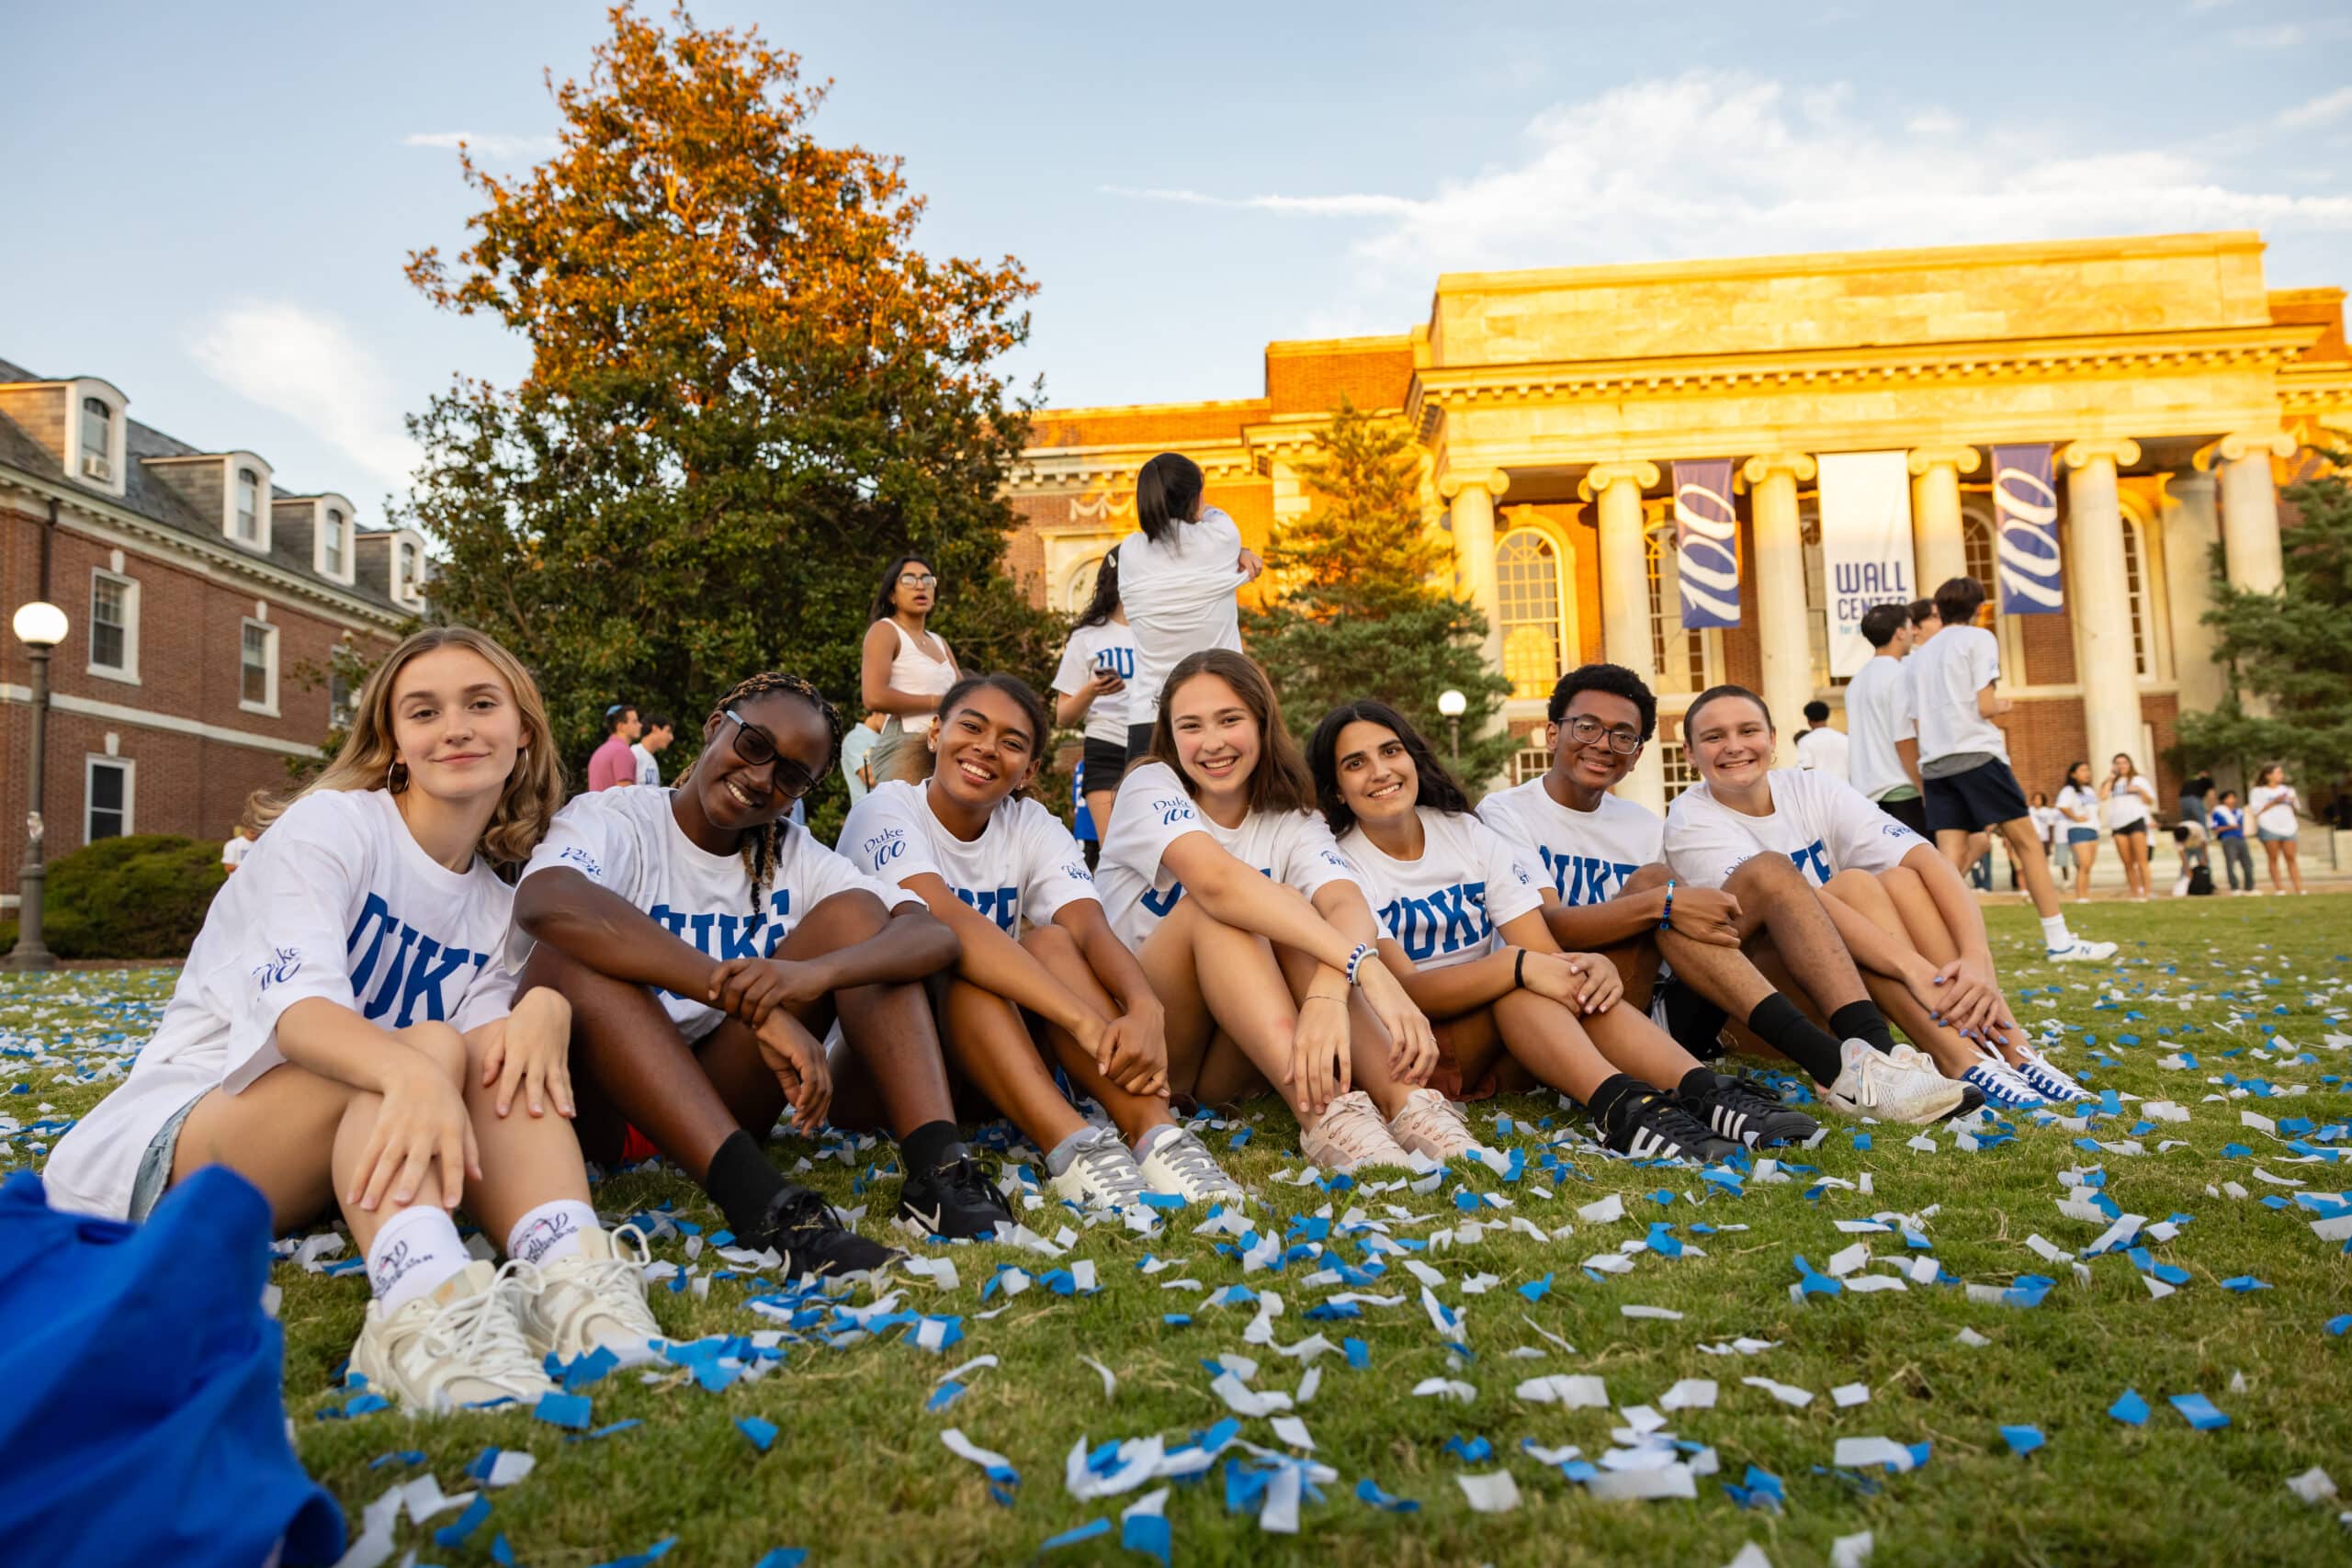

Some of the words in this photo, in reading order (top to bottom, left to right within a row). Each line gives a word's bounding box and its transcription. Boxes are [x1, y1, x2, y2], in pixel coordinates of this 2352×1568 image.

[1674, 483, 1741, 621] 100
[1992, 467, 2064, 608] 100
[1836, 561, 1906, 593] WALL
[1096, 646, 1135, 679] DU
[865, 828, 904, 853] Duke
[875, 840, 906, 871] 100
[346, 891, 490, 1029] DUK
